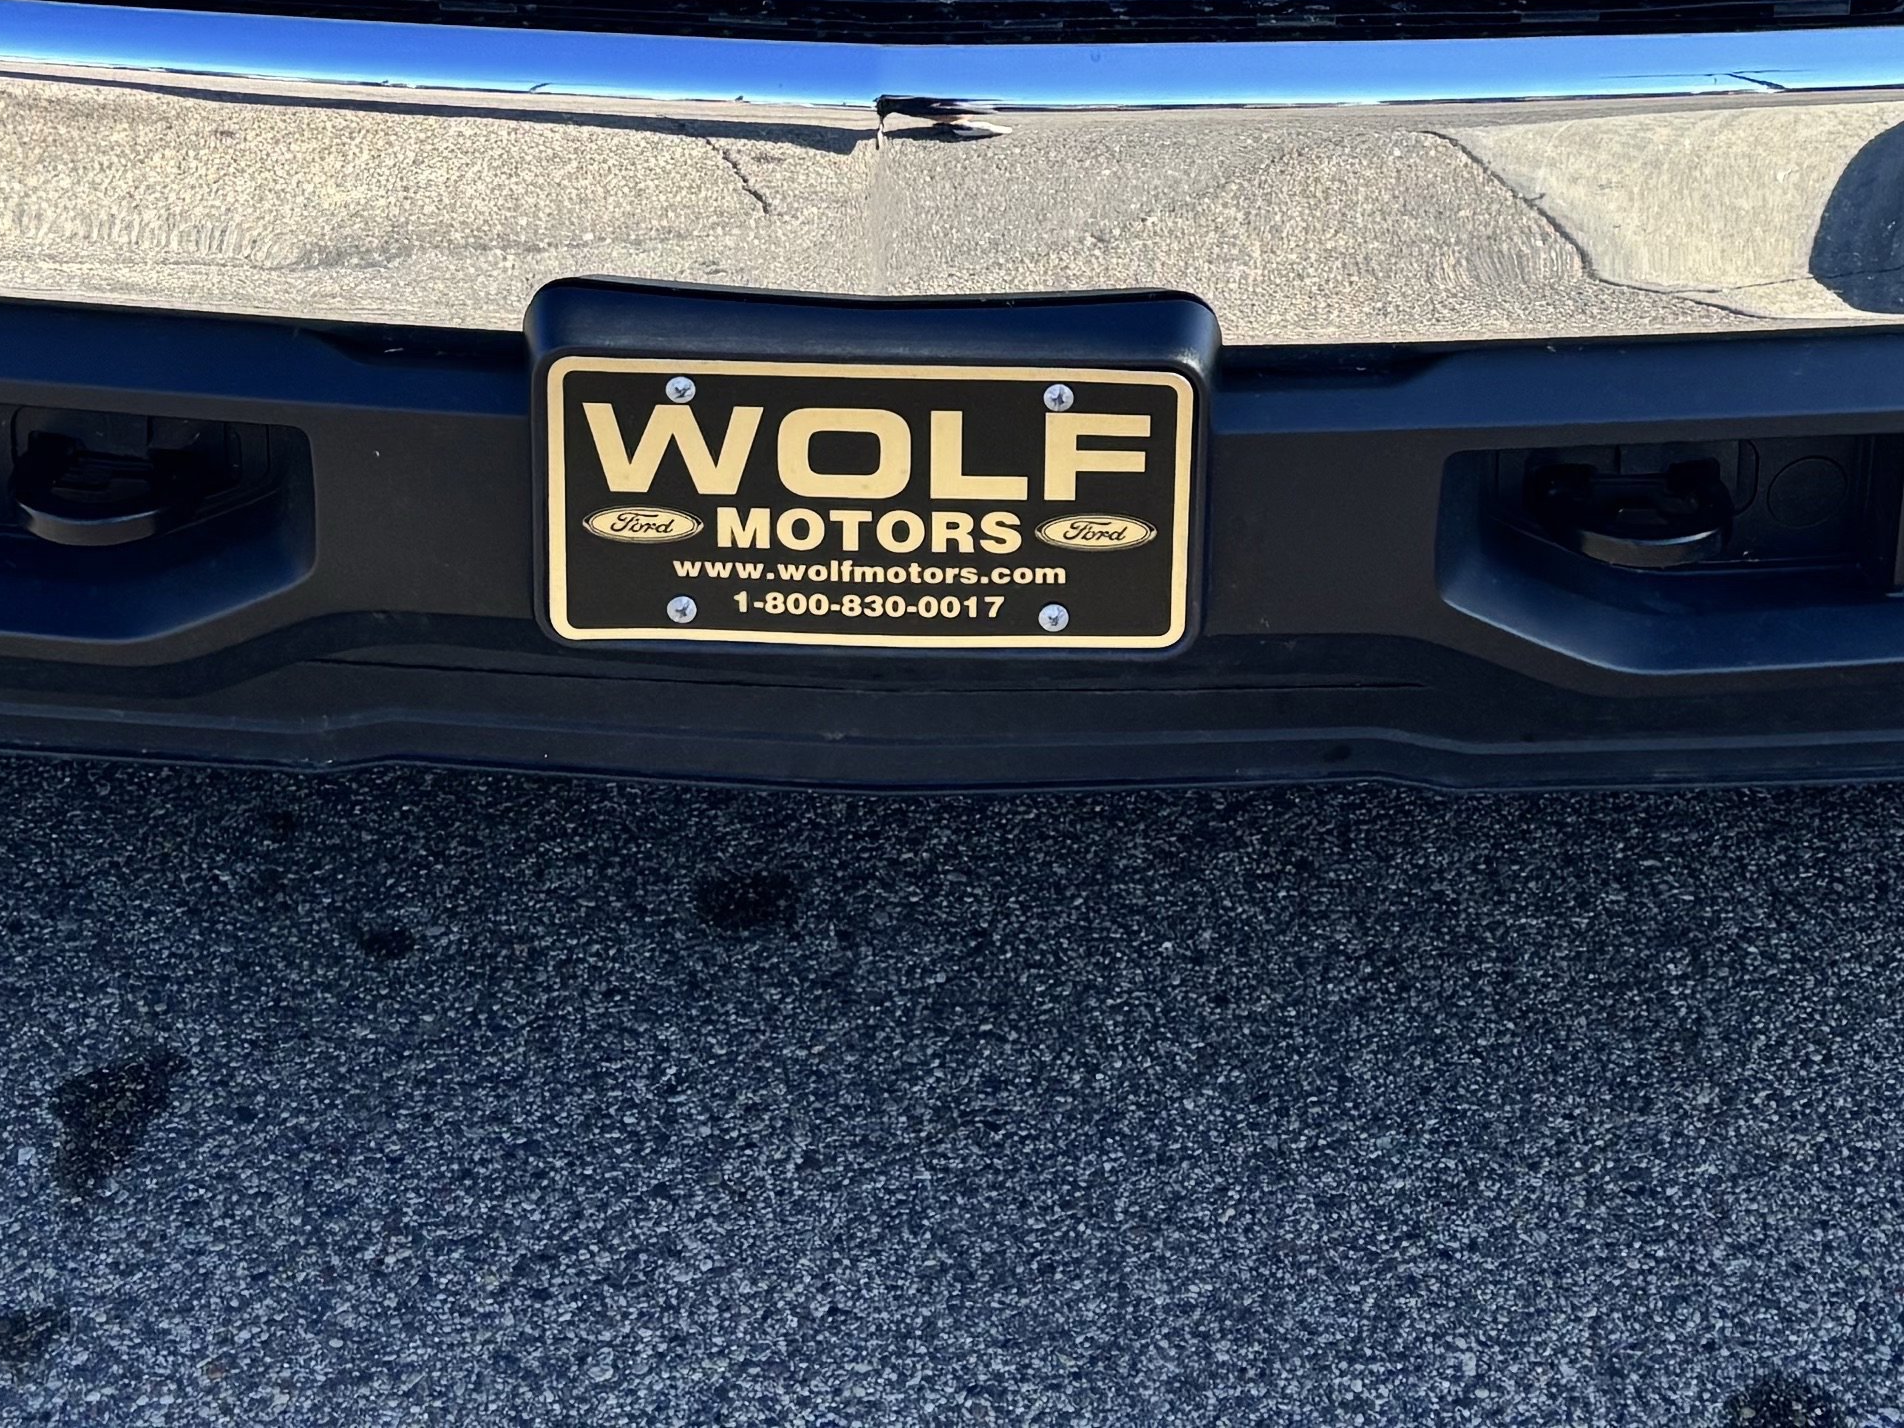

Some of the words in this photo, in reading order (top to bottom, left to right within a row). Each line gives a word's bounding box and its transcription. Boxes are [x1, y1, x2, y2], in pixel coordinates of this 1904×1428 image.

[582, 402, 1151, 502] WOLF
[609, 509, 674, 536] Ford
[716, 506, 1023, 555] MOTORS
[1063, 518, 1128, 544] Ford
[673, 558, 1066, 585] www.wolfmotors.com
[733, 590, 1005, 620] 1-800-830-0017
